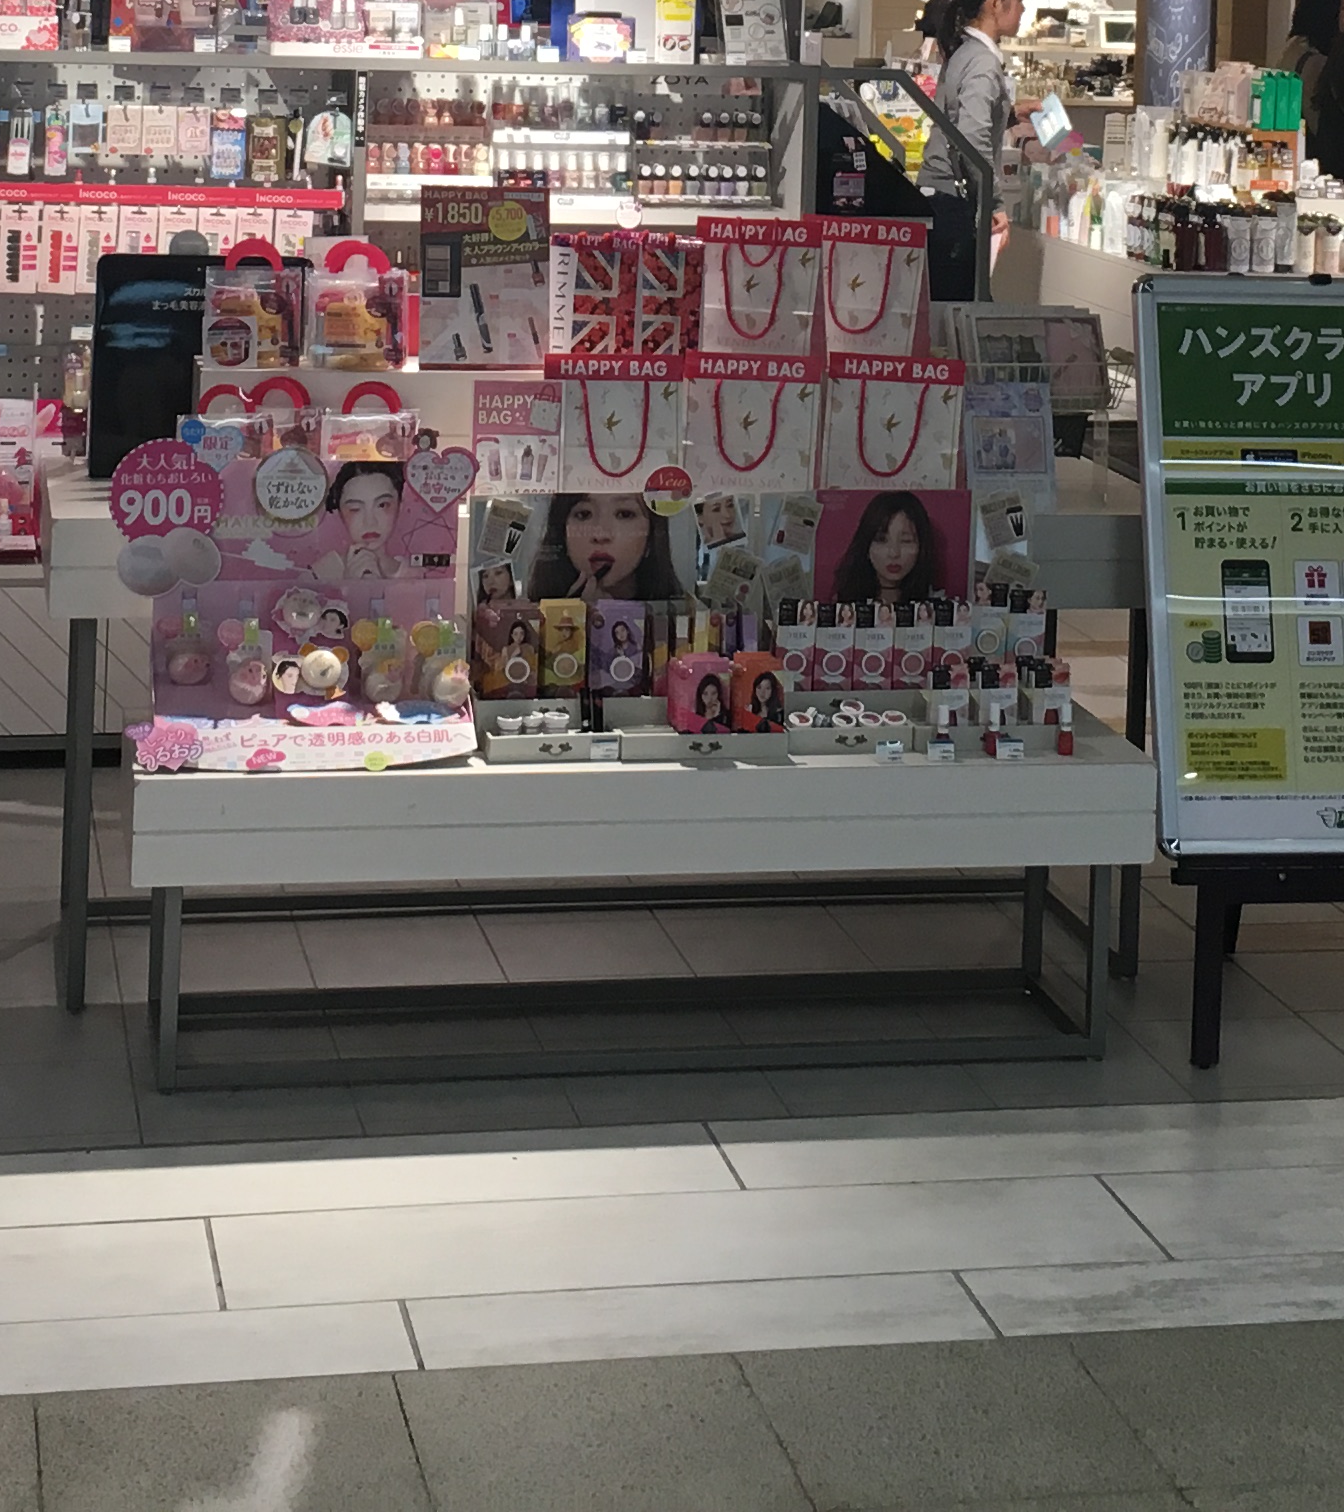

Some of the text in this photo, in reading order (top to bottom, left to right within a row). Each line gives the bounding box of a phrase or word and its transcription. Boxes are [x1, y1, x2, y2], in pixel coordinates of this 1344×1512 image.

[333, 43, 364, 55] essie
[650, 75, 709, 86] ZOYA
[79, 189, 117, 199] INCOCO
[168, 191, 206, 202] INCOCO
[256, 193, 294, 203] INCOCO
[424, 190, 488, 199] HAPPY BAG
[878, 226, 912, 242] BAG
[463, 242, 548, 256] 大人ブラウンアイカラー
[560, 359, 668, 377] HAPPY BAG
[700, 358, 805, 378] HAPPY BAG
[844, 358, 950, 380] HAPPY BAG
[1232, 371, 1333, 408] アプリ
[478, 394, 534, 409] HAPPY
[478, 410, 513, 425] BAG
[203, 435, 234, 451] 限定
[137, 453, 197, 471] 大人気！
[120, 472, 212, 485] 化粧もちおしろい
[657, 471, 688, 487] New
[266, 481, 318, 494] くずれない
[119, 488, 211, 526] 900円
[268, 496, 315, 510] 乾かない
[1193, 506, 1250, 517] お買い物で
[1176, 512, 1186, 531] 1
[1194, 521, 1248, 533] ポイントが
[1290, 513, 1303, 532] 2
[1194, 536, 1278, 549] 貯まる・使える！
[144, 729, 185, 747] しっとり
[239, 729, 471, 748] ピュアで透明感のある白肌へ
[138, 740, 202, 771] うるおう
[252, 751, 277, 765] NEW
